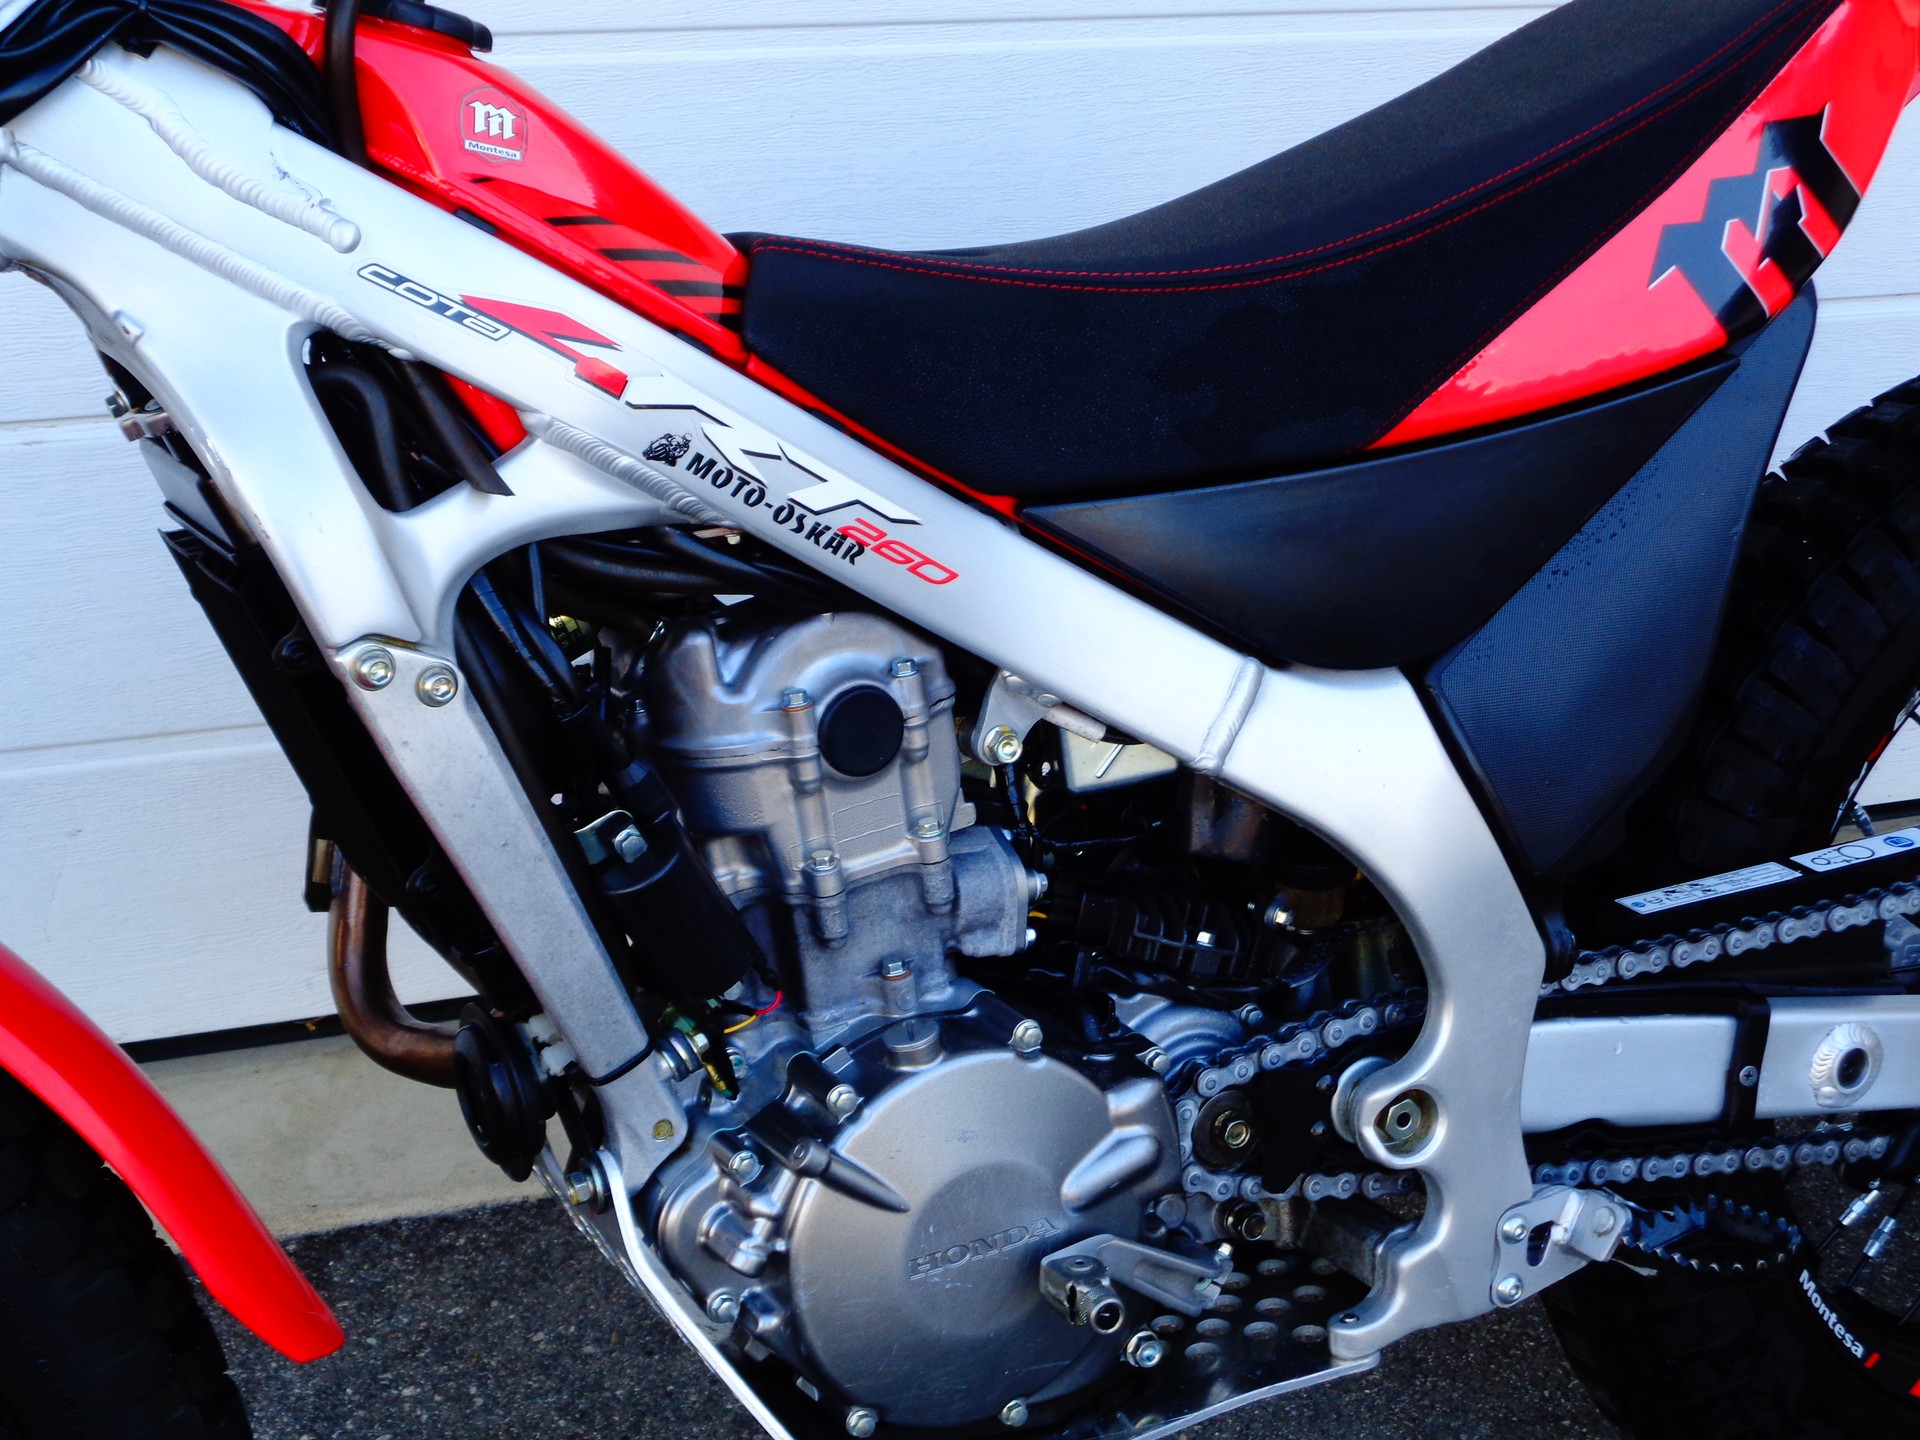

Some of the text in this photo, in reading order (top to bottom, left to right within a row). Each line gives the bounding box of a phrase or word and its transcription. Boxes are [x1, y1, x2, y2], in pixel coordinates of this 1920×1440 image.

[468, 141, 517, 158] Montesa
[836, 517, 959, 585] 260
[908, 1217, 1060, 1281] HONDA
[1799, 1268, 1865, 1359] Montesa
